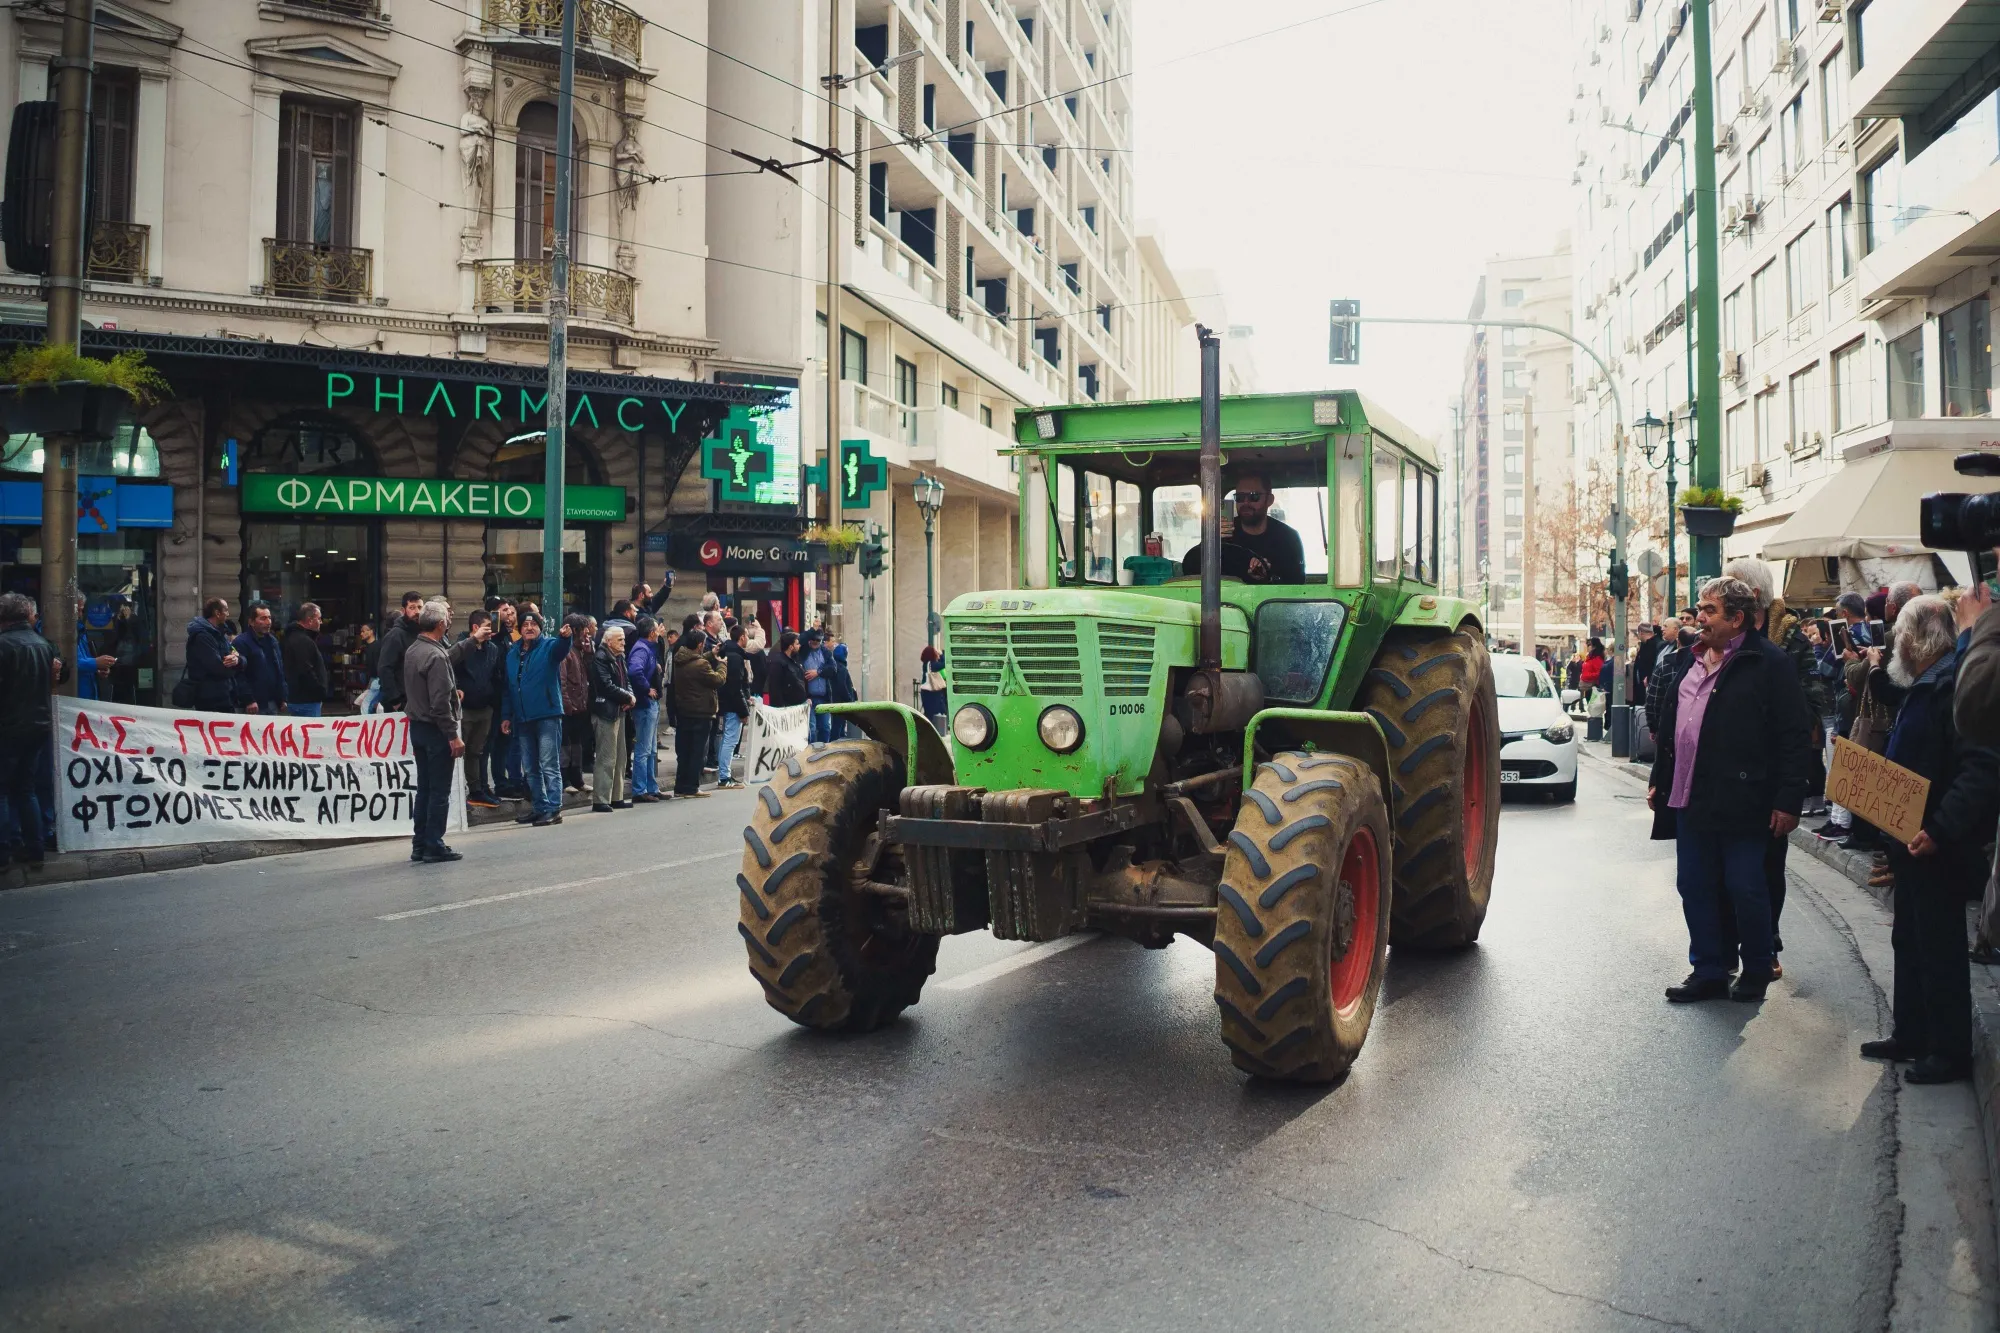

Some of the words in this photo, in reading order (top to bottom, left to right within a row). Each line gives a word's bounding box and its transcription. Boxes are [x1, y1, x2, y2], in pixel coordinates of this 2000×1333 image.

[327, 373, 686, 434] PHARMACY
[277, 478, 532, 516] ΦΑΡΜΑΚΕΙΟ
[566, 508, 617, 517] ΣΤΑΥΡΟΠΟΥΛΟΥ
[173, 719, 325, 759] ΠΕΛΛΑΣ
[202, 759, 361, 793] ΞΕΚΛΗΡΙΣΜΑ
[370, 760, 418, 790] ΤΗΣ
